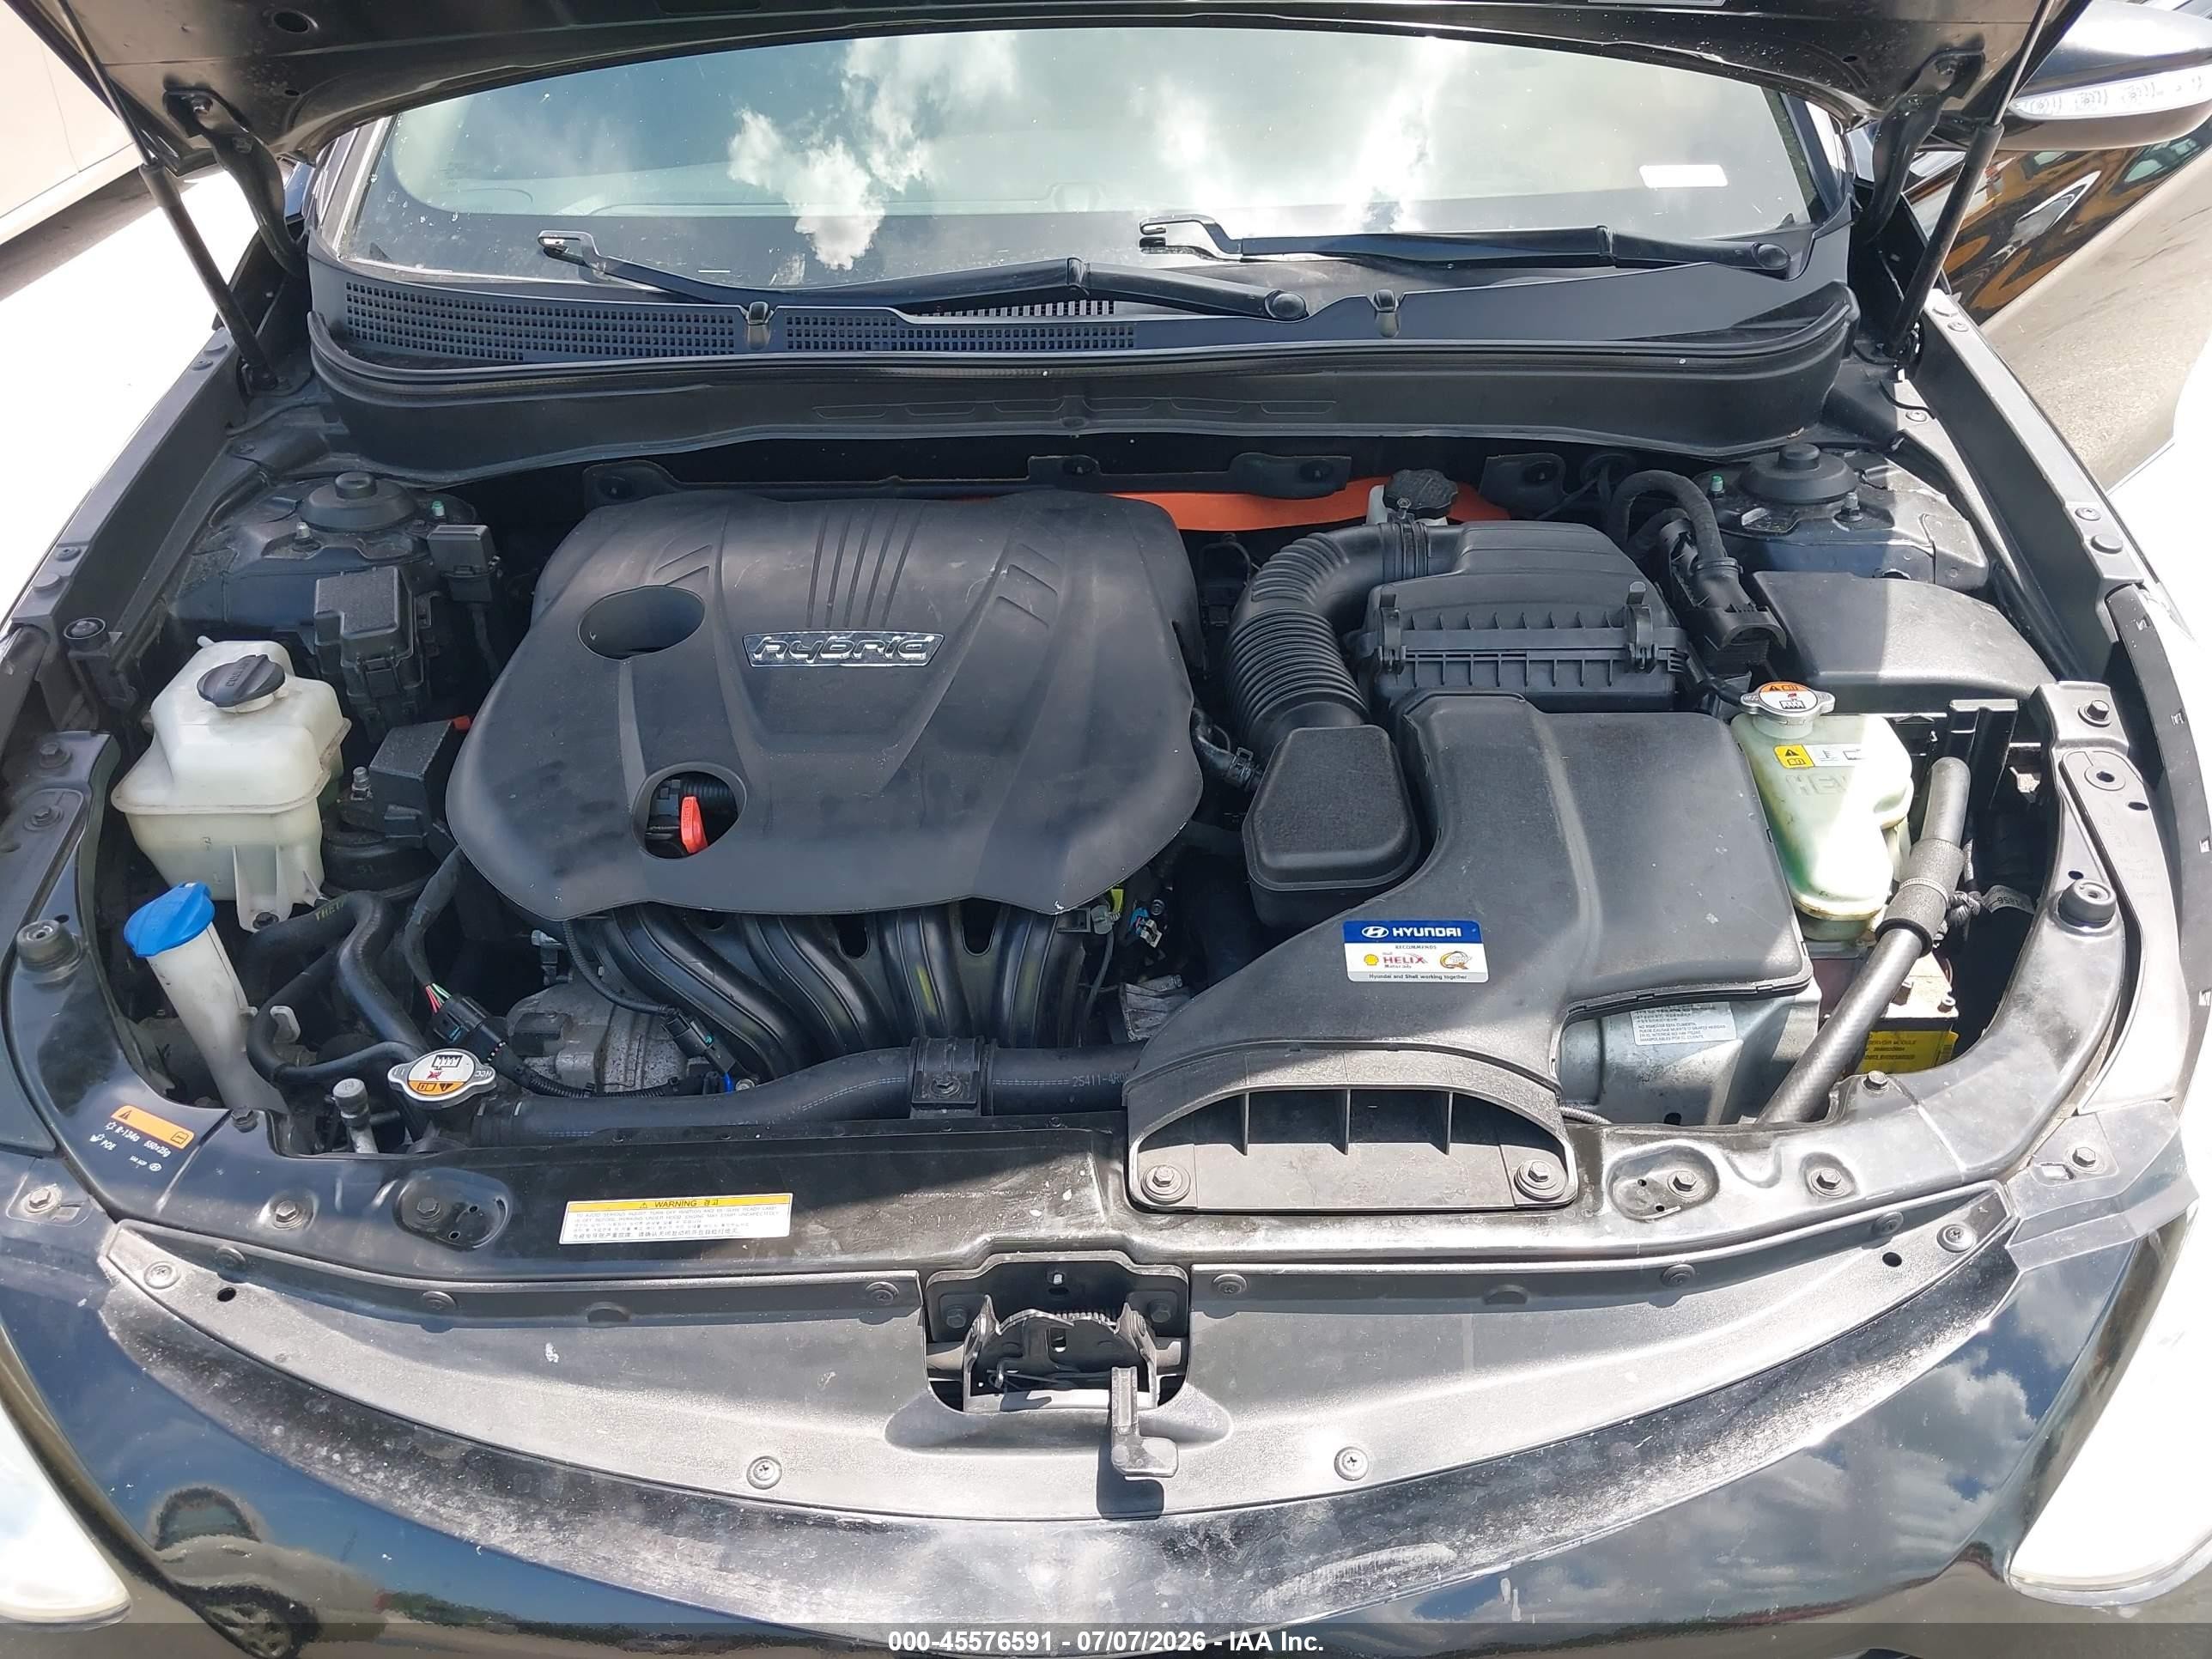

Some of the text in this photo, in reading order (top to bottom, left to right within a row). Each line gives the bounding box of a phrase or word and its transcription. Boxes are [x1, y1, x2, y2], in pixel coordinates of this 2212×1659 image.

[752, 635, 934, 663] hybrid
[1392, 927, 1462, 938] HYUNDAI
[1382, 956, 1425, 964] HELIX
